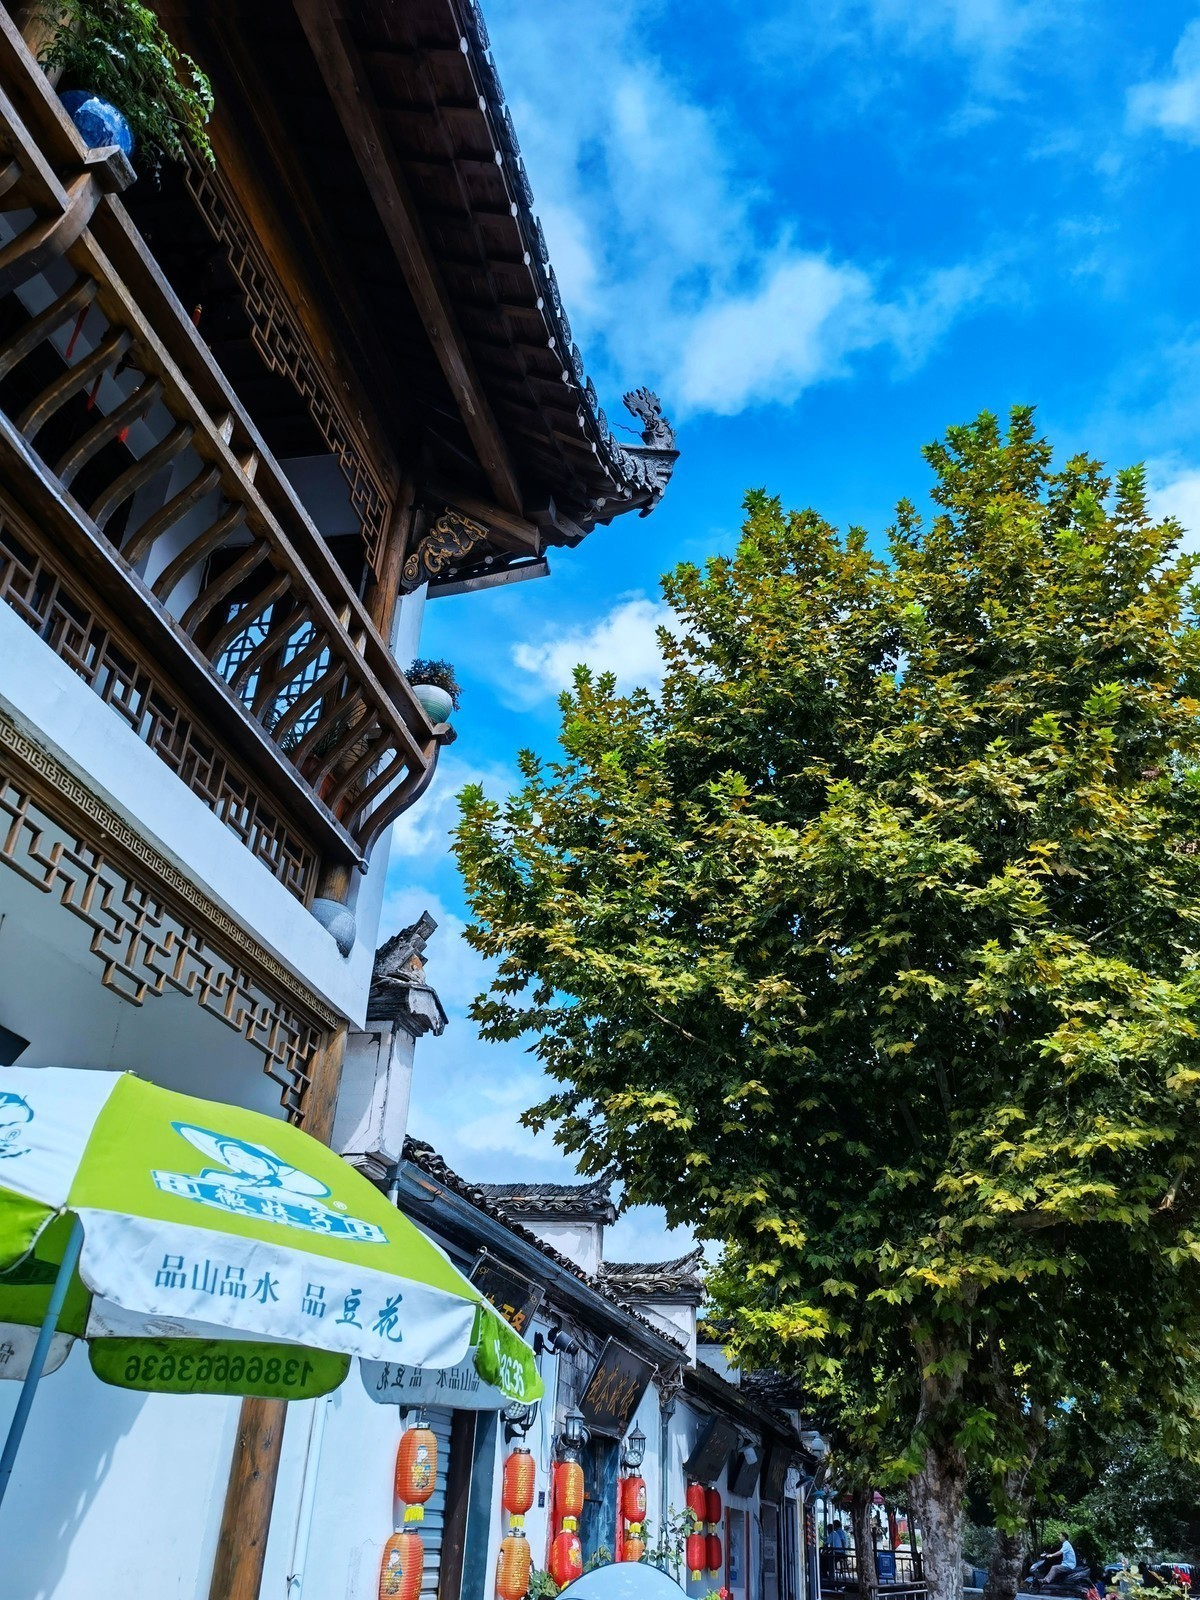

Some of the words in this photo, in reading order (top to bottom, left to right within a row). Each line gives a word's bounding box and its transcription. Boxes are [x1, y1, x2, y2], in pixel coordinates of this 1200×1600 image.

[155, 1253, 280, 1304] 品山品水
[301, 1283, 403, 1343] 品豆花
